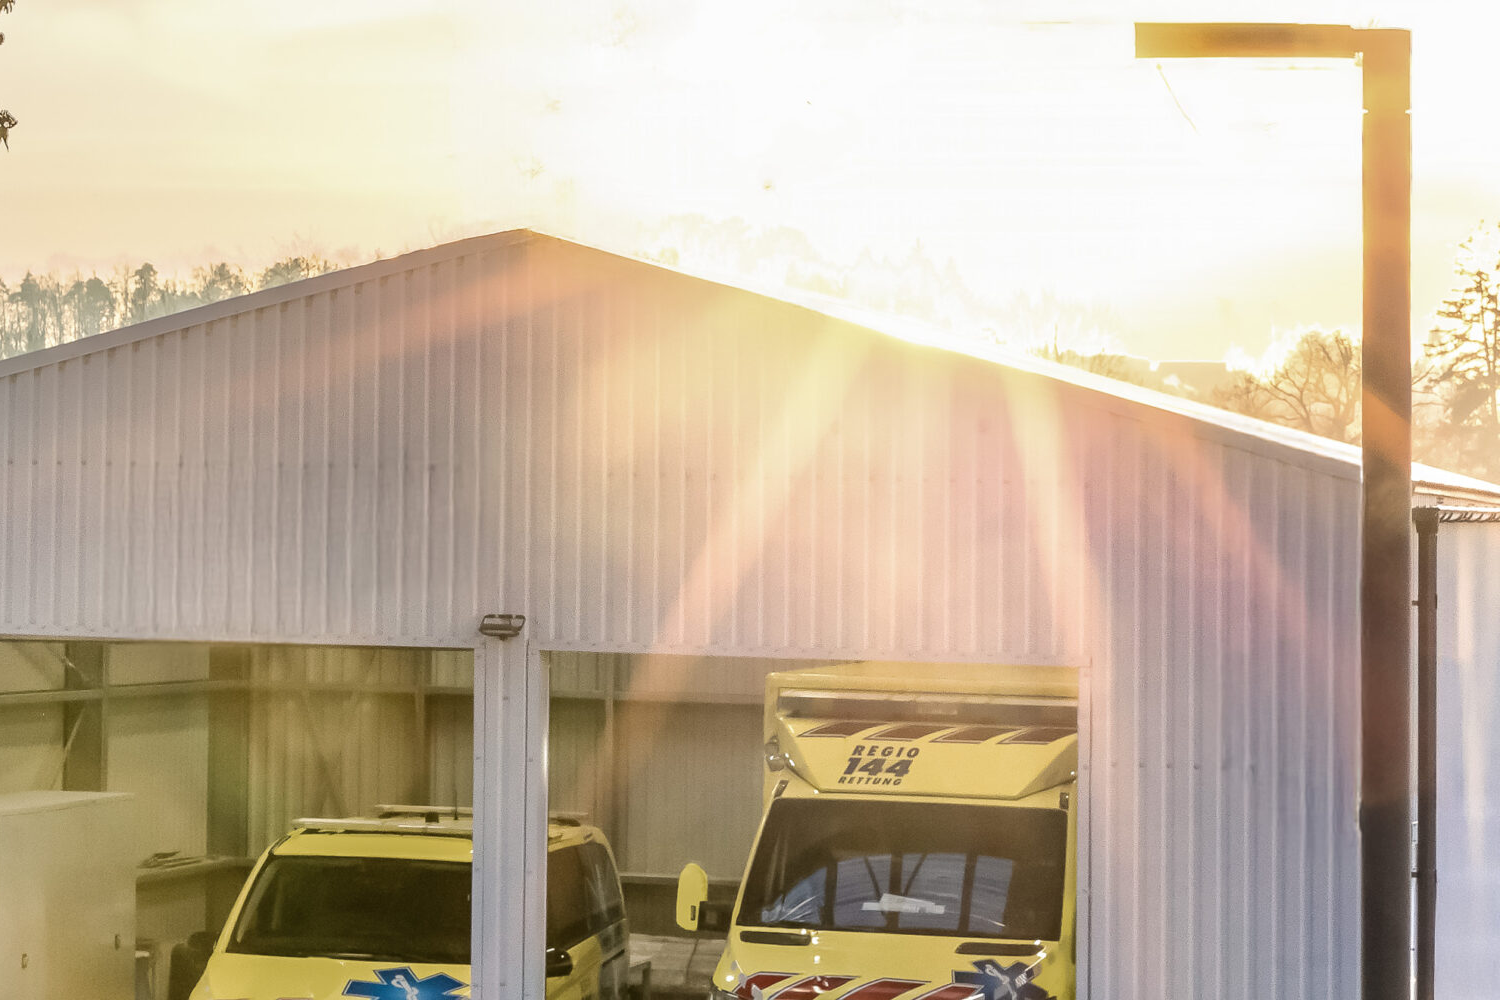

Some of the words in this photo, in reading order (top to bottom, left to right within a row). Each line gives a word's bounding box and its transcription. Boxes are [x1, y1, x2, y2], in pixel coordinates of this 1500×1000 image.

[851, 745, 920, 758] REGIO
[843, 757, 914, 777] 144
[837, 776, 902, 786] RETTUNG
